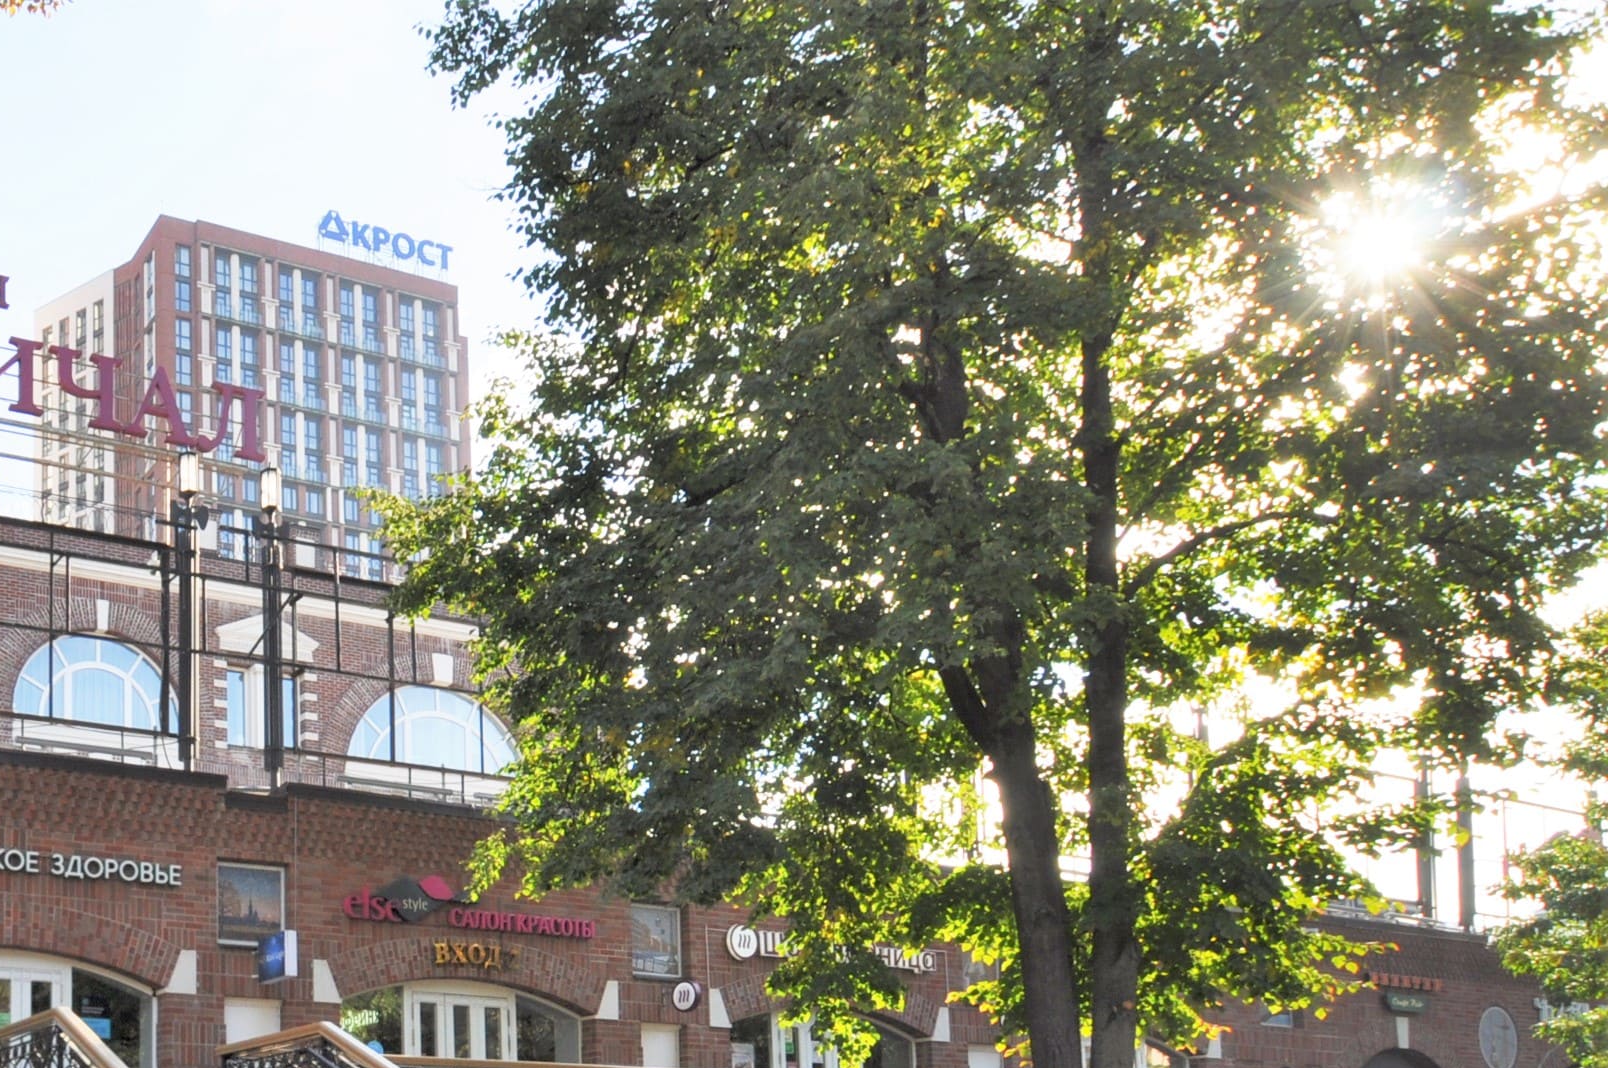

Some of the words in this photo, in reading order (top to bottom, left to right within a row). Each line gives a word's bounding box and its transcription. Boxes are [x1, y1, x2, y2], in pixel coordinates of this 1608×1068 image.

[351, 220, 454, 270] КРОСТ
[50, 852, 183, 886] ЗДОРОВЬЕ
[401, 897, 429, 913] style
[449, 907, 512, 932] САЛОН
[516, 912, 597, 939] КРАСОТЫ
[434, 943, 502, 969] ВХОД
